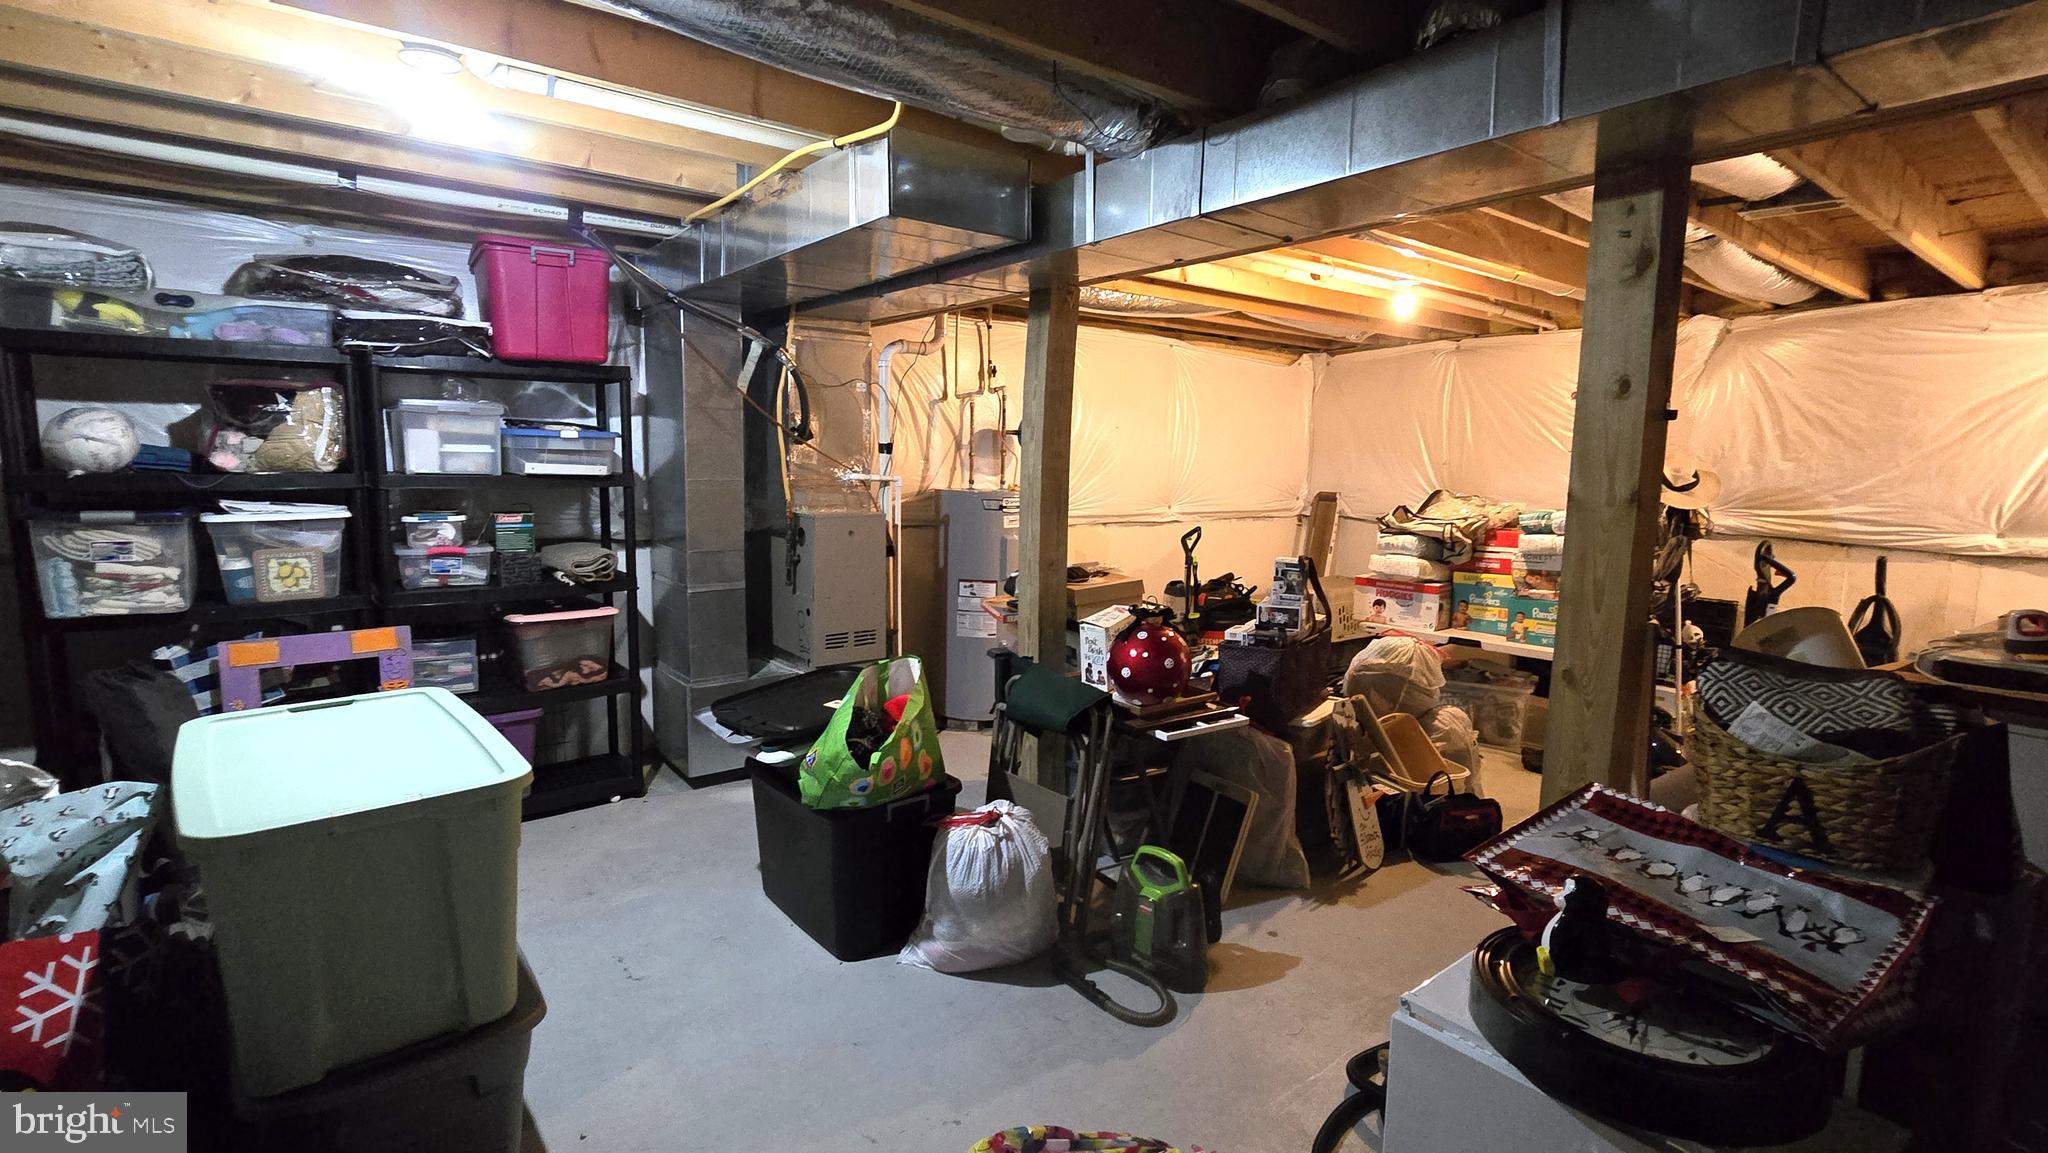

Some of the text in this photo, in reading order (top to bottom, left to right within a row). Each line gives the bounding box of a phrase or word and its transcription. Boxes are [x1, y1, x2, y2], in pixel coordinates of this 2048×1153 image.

[1375, 587, 1414, 601] HUGGIES
[1469, 593, 1500, 606] Pampers
[1756, 776, 1831, 852] A
